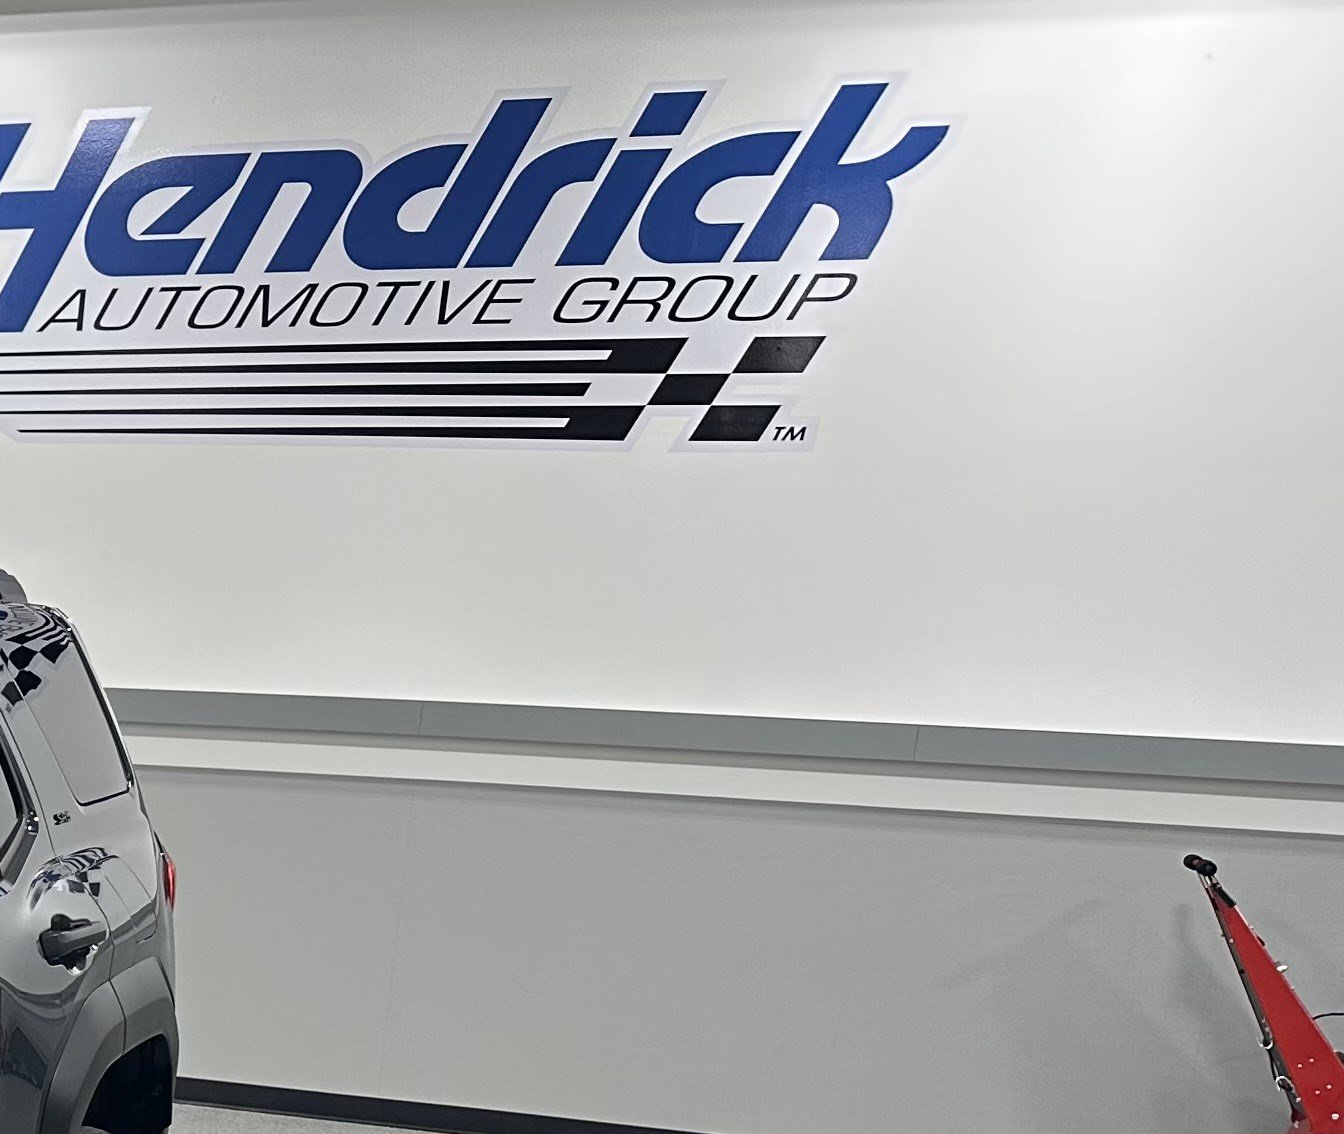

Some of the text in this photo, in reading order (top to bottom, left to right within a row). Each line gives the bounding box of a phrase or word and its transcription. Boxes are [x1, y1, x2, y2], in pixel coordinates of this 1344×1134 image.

[37, 272, 859, 333] AUTOMOTIVE GROUP
[773, 426, 808, 442] TM
